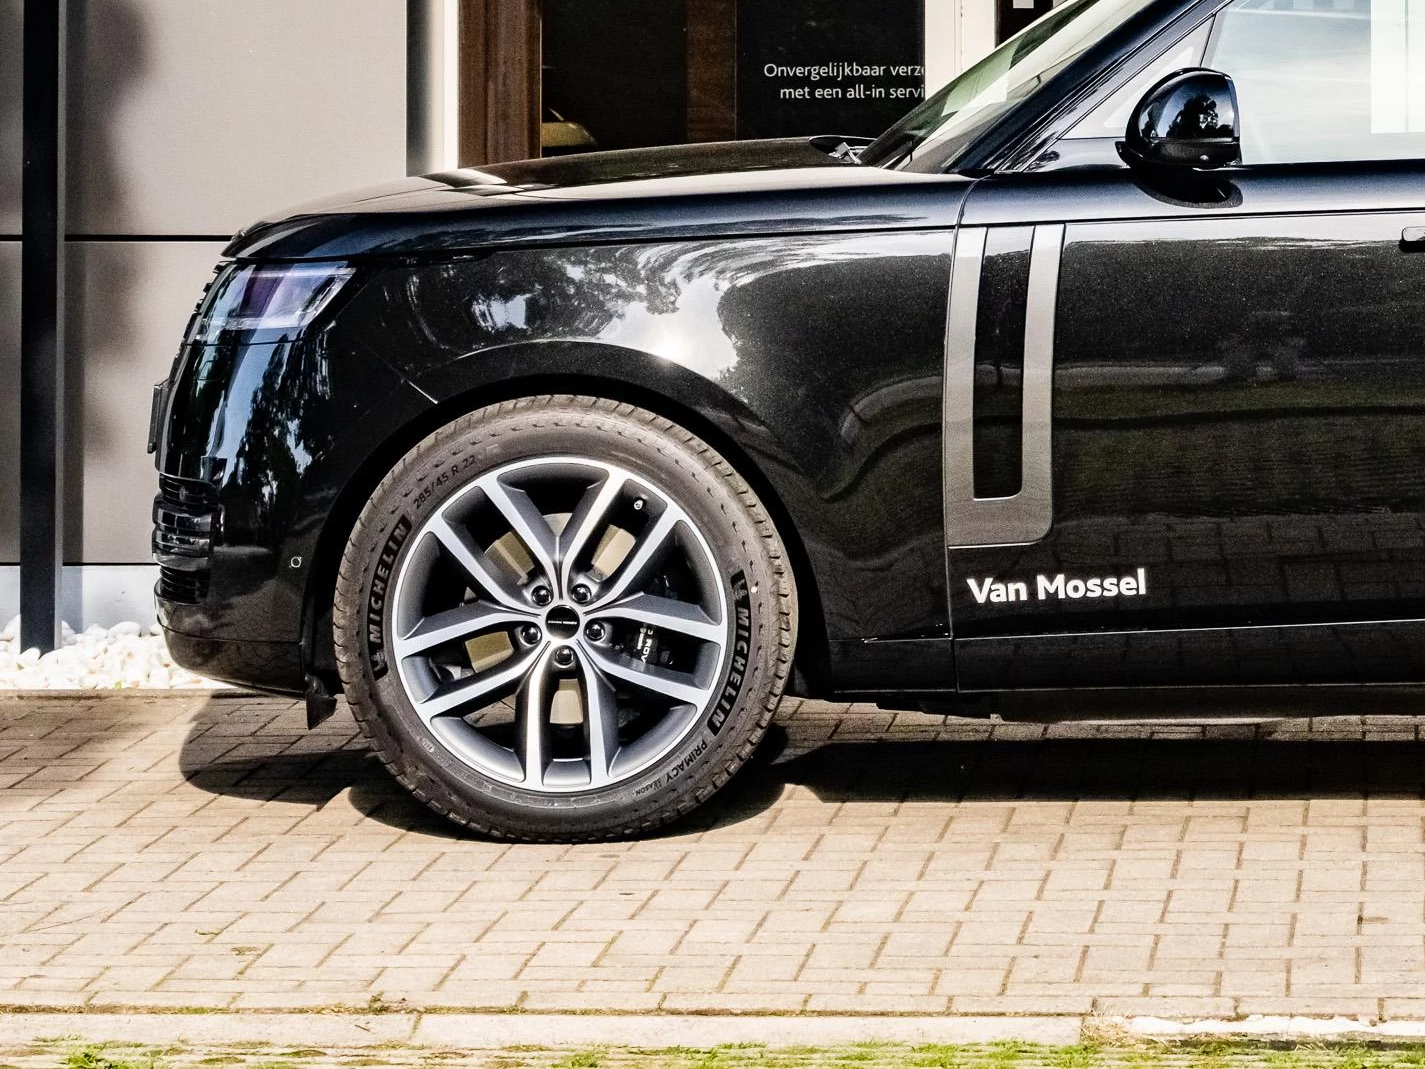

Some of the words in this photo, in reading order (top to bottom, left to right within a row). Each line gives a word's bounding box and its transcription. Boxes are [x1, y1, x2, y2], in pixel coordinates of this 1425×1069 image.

[763, 62, 886, 81] Onvergelijkbaar
[779, 86, 811, 99] met
[814, 87, 842, 99] een
[846, 83, 885, 99] all-in
[413, 471, 449, 509] 285/45
[451, 465, 460, 476] R
[462, 454, 476, 469] 22
[369, 522, 408, 644] MICHELIN
[966, 577, 1028, 604] Van
[1036, 567, 1147, 600] Mossel
[711, 607, 750, 728] MICHELIN
[665, 738, 708, 784] PRIMACY
